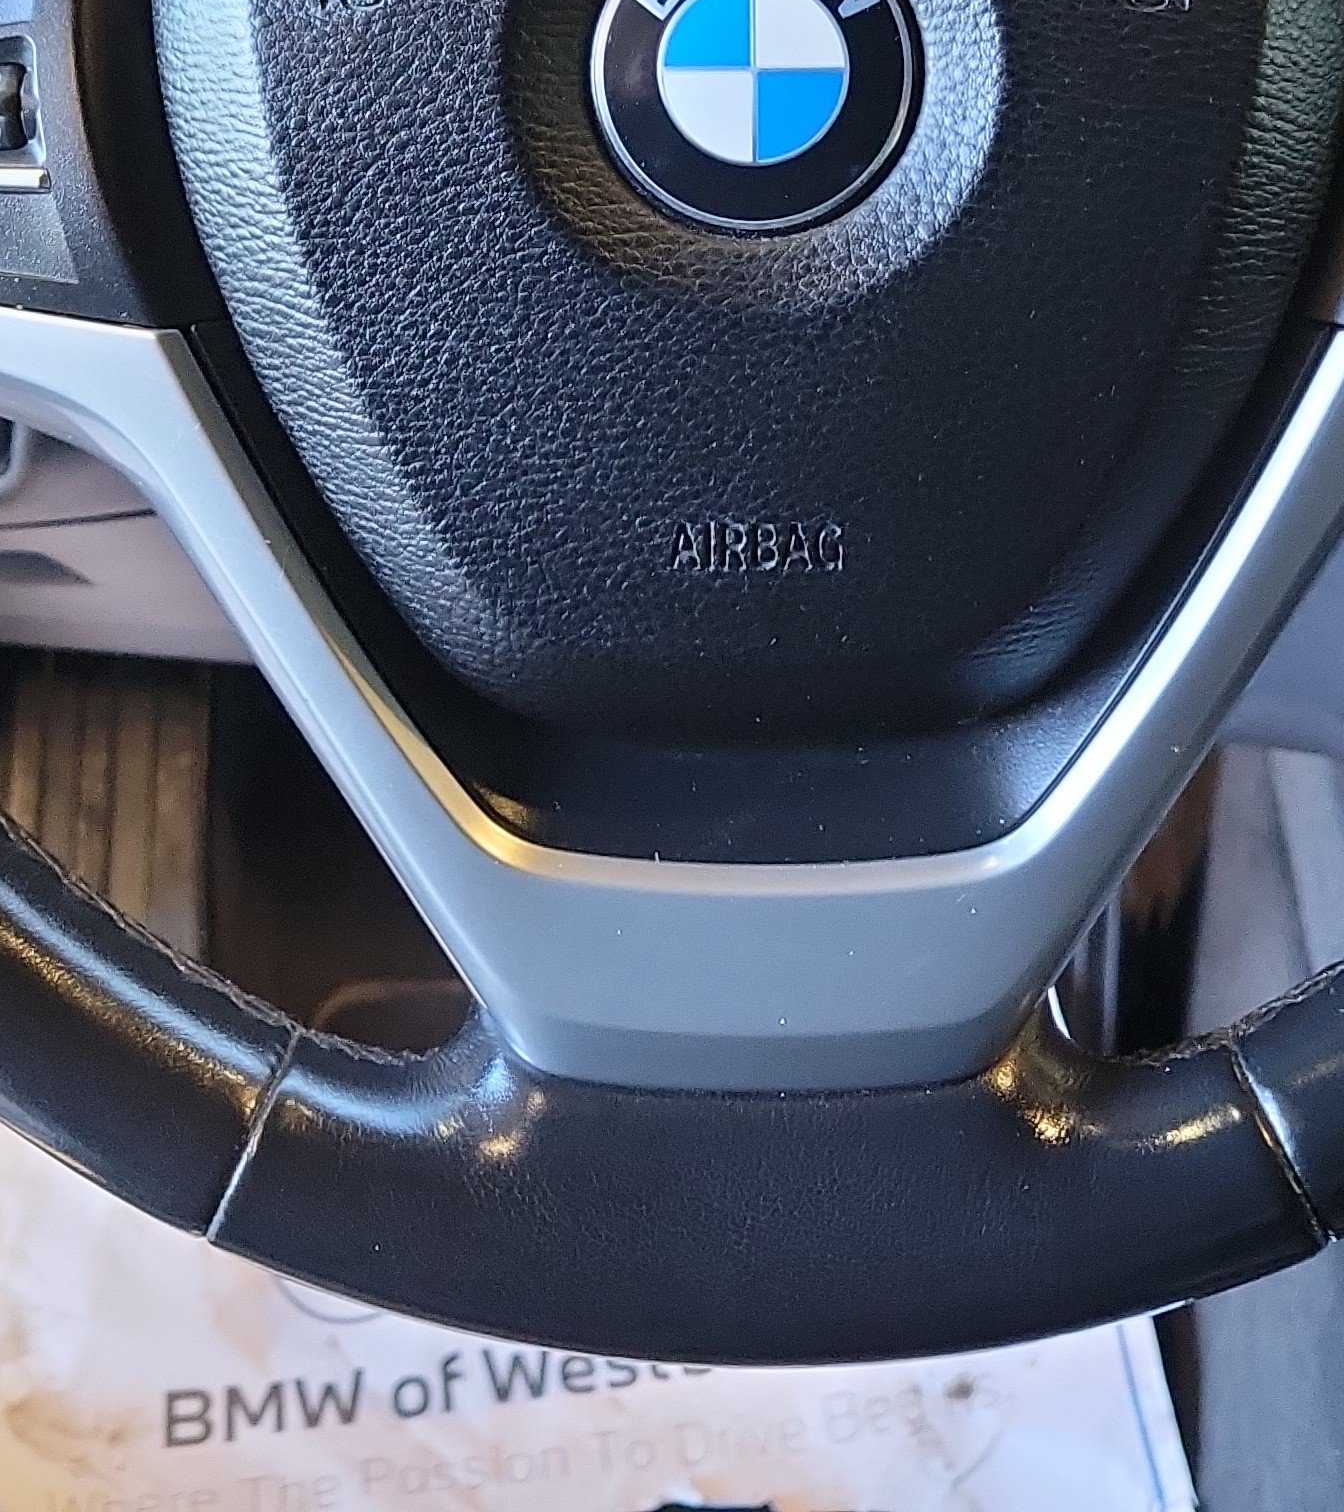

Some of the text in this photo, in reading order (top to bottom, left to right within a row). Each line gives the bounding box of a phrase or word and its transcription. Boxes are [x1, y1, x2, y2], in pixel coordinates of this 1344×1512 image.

[666, 519, 844, 574] AIRBAG
[162, 1367, 365, 1448] BMW
[389, 1352, 464, 1421] of
